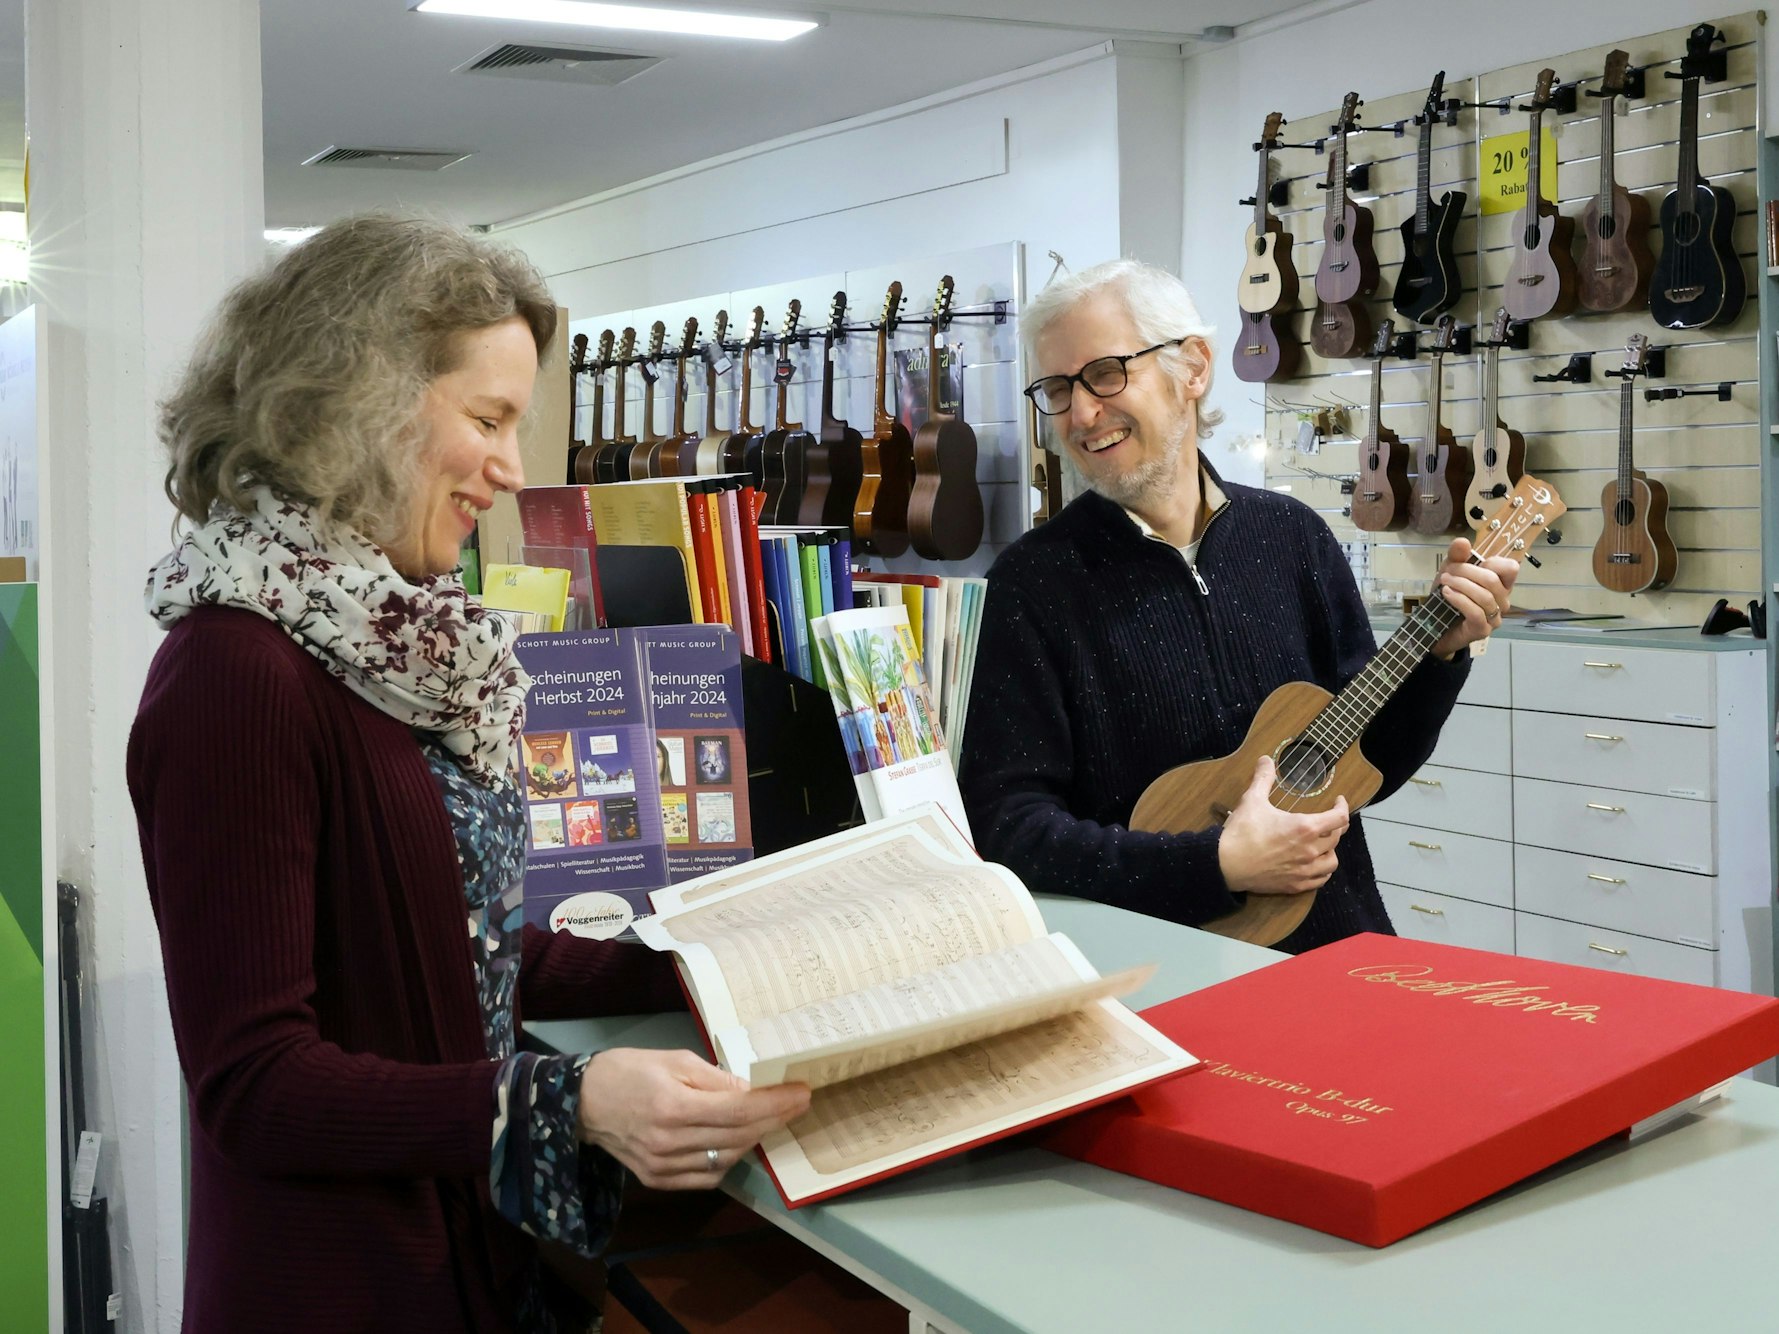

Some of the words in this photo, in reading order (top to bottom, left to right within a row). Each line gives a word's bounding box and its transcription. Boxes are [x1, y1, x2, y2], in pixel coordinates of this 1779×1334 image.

[1492, 149, 1514, 175] 20
[1500, 182, 1529, 197] Raba
[586, 511, 594, 532] SONGS
[684, 525, 692, 549] SONGS
[517, 640, 549, 649] SCHOTT
[552, 638, 579, 647] MUSIC
[582, 637, 611, 645] GROUP
[530, 669, 622, 686] scheinungen
[650, 670, 725, 689] heinungen
[535, 689, 583, 706] Herbst
[586, 686, 625, 703] 2024
[651, 690, 686, 709] hjahr
[690, 690, 727, 705] 2024
[607, 708, 626, 716] Digital
[560, 859, 595, 868] Spielliteratur
[600, 854, 644, 863] Musikpädagogik
[575, 866, 610, 875] Wissenschaft
[615, 863, 646, 872] Musikbuch
[670, 865, 704, 873] Wissenschaft
[566, 912, 624, 925] Voggenreiter
[1315, 1088, 1394, 1115] B-dur
[1285, 1100, 1335, 1120] Opus
[1333, 1113, 1369, 1125] 97
